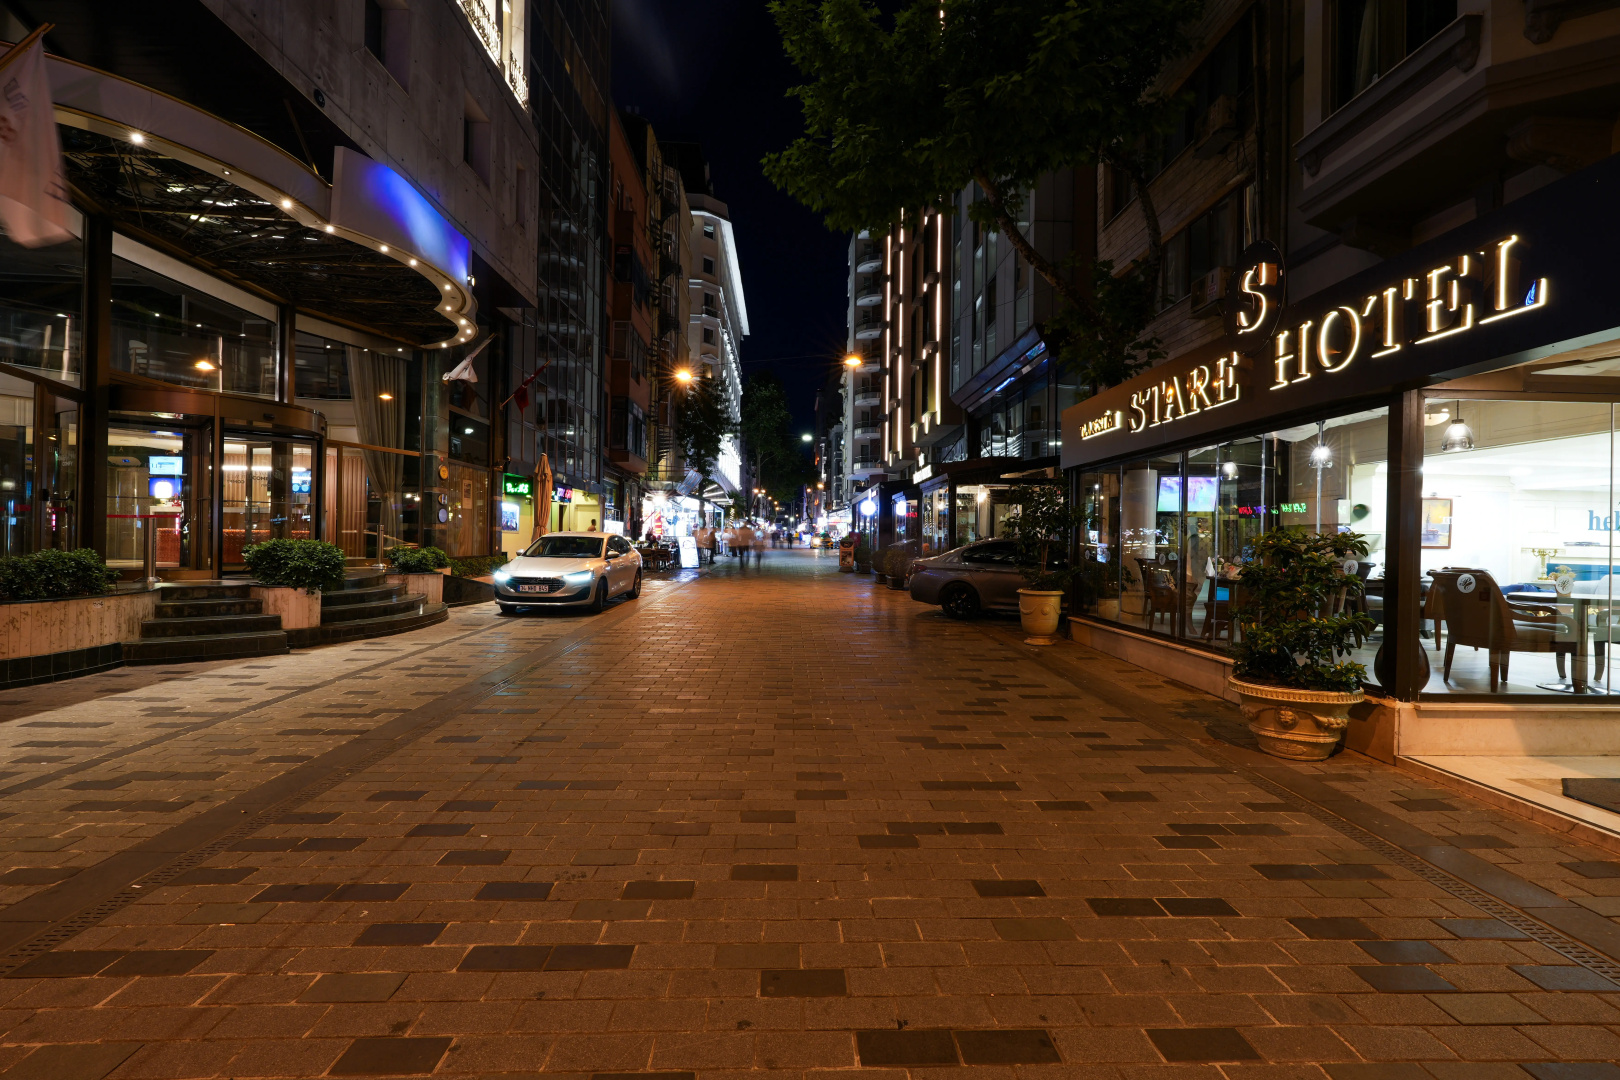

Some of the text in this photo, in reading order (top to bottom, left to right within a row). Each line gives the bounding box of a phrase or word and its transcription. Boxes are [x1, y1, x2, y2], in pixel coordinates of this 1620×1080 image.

[1127, 351, 1240, 433] STARE
[1268, 234, 1547, 391] HOTEL
[1235, 261, 1272, 334] S
